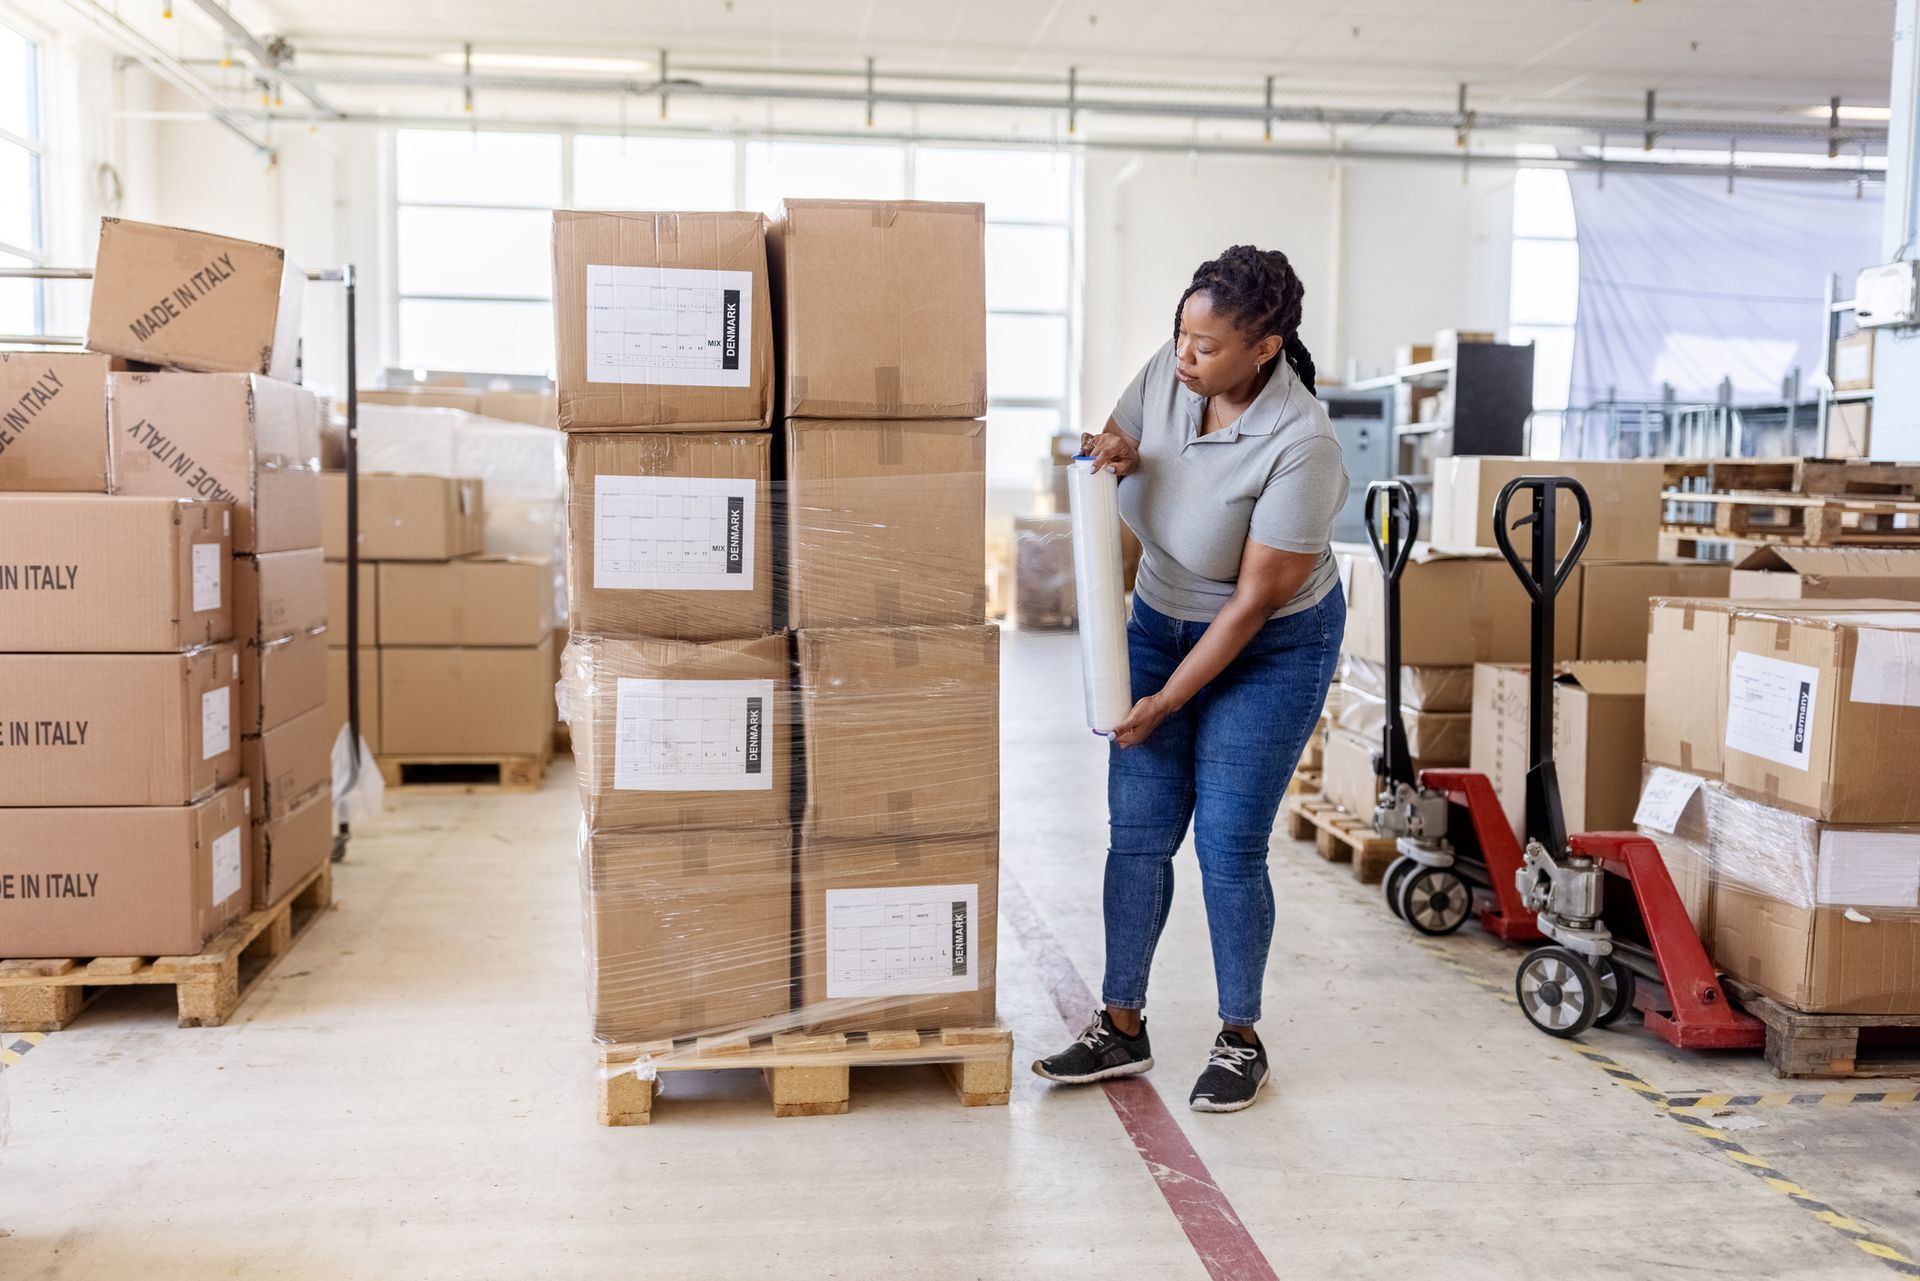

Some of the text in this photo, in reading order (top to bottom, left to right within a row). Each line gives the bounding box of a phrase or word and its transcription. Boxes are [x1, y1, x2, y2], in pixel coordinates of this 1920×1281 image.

[129, 252, 236, 342] MADE IN ITALY
[726, 303, 736, 357] DENMARK
[3, 407, 30, 433] IN
[19, 368, 64, 417] ITALY
[127, 419, 177, 463] ITALY
[168, 452, 195, 477] IN
[730, 509, 740, 561] DENMARK
[0, 565, 78, 590] IN ITALY
[10, 721, 29, 746] IN
[35, 720, 88, 746] ITALY
[749, 709, 759, 761] DENMARK
[1795, 691, 1809, 743] Germany
[21, 874, 40, 899] IN
[46, 873, 98, 898] ITALY
[955, 913, 964, 964] DENMARK
